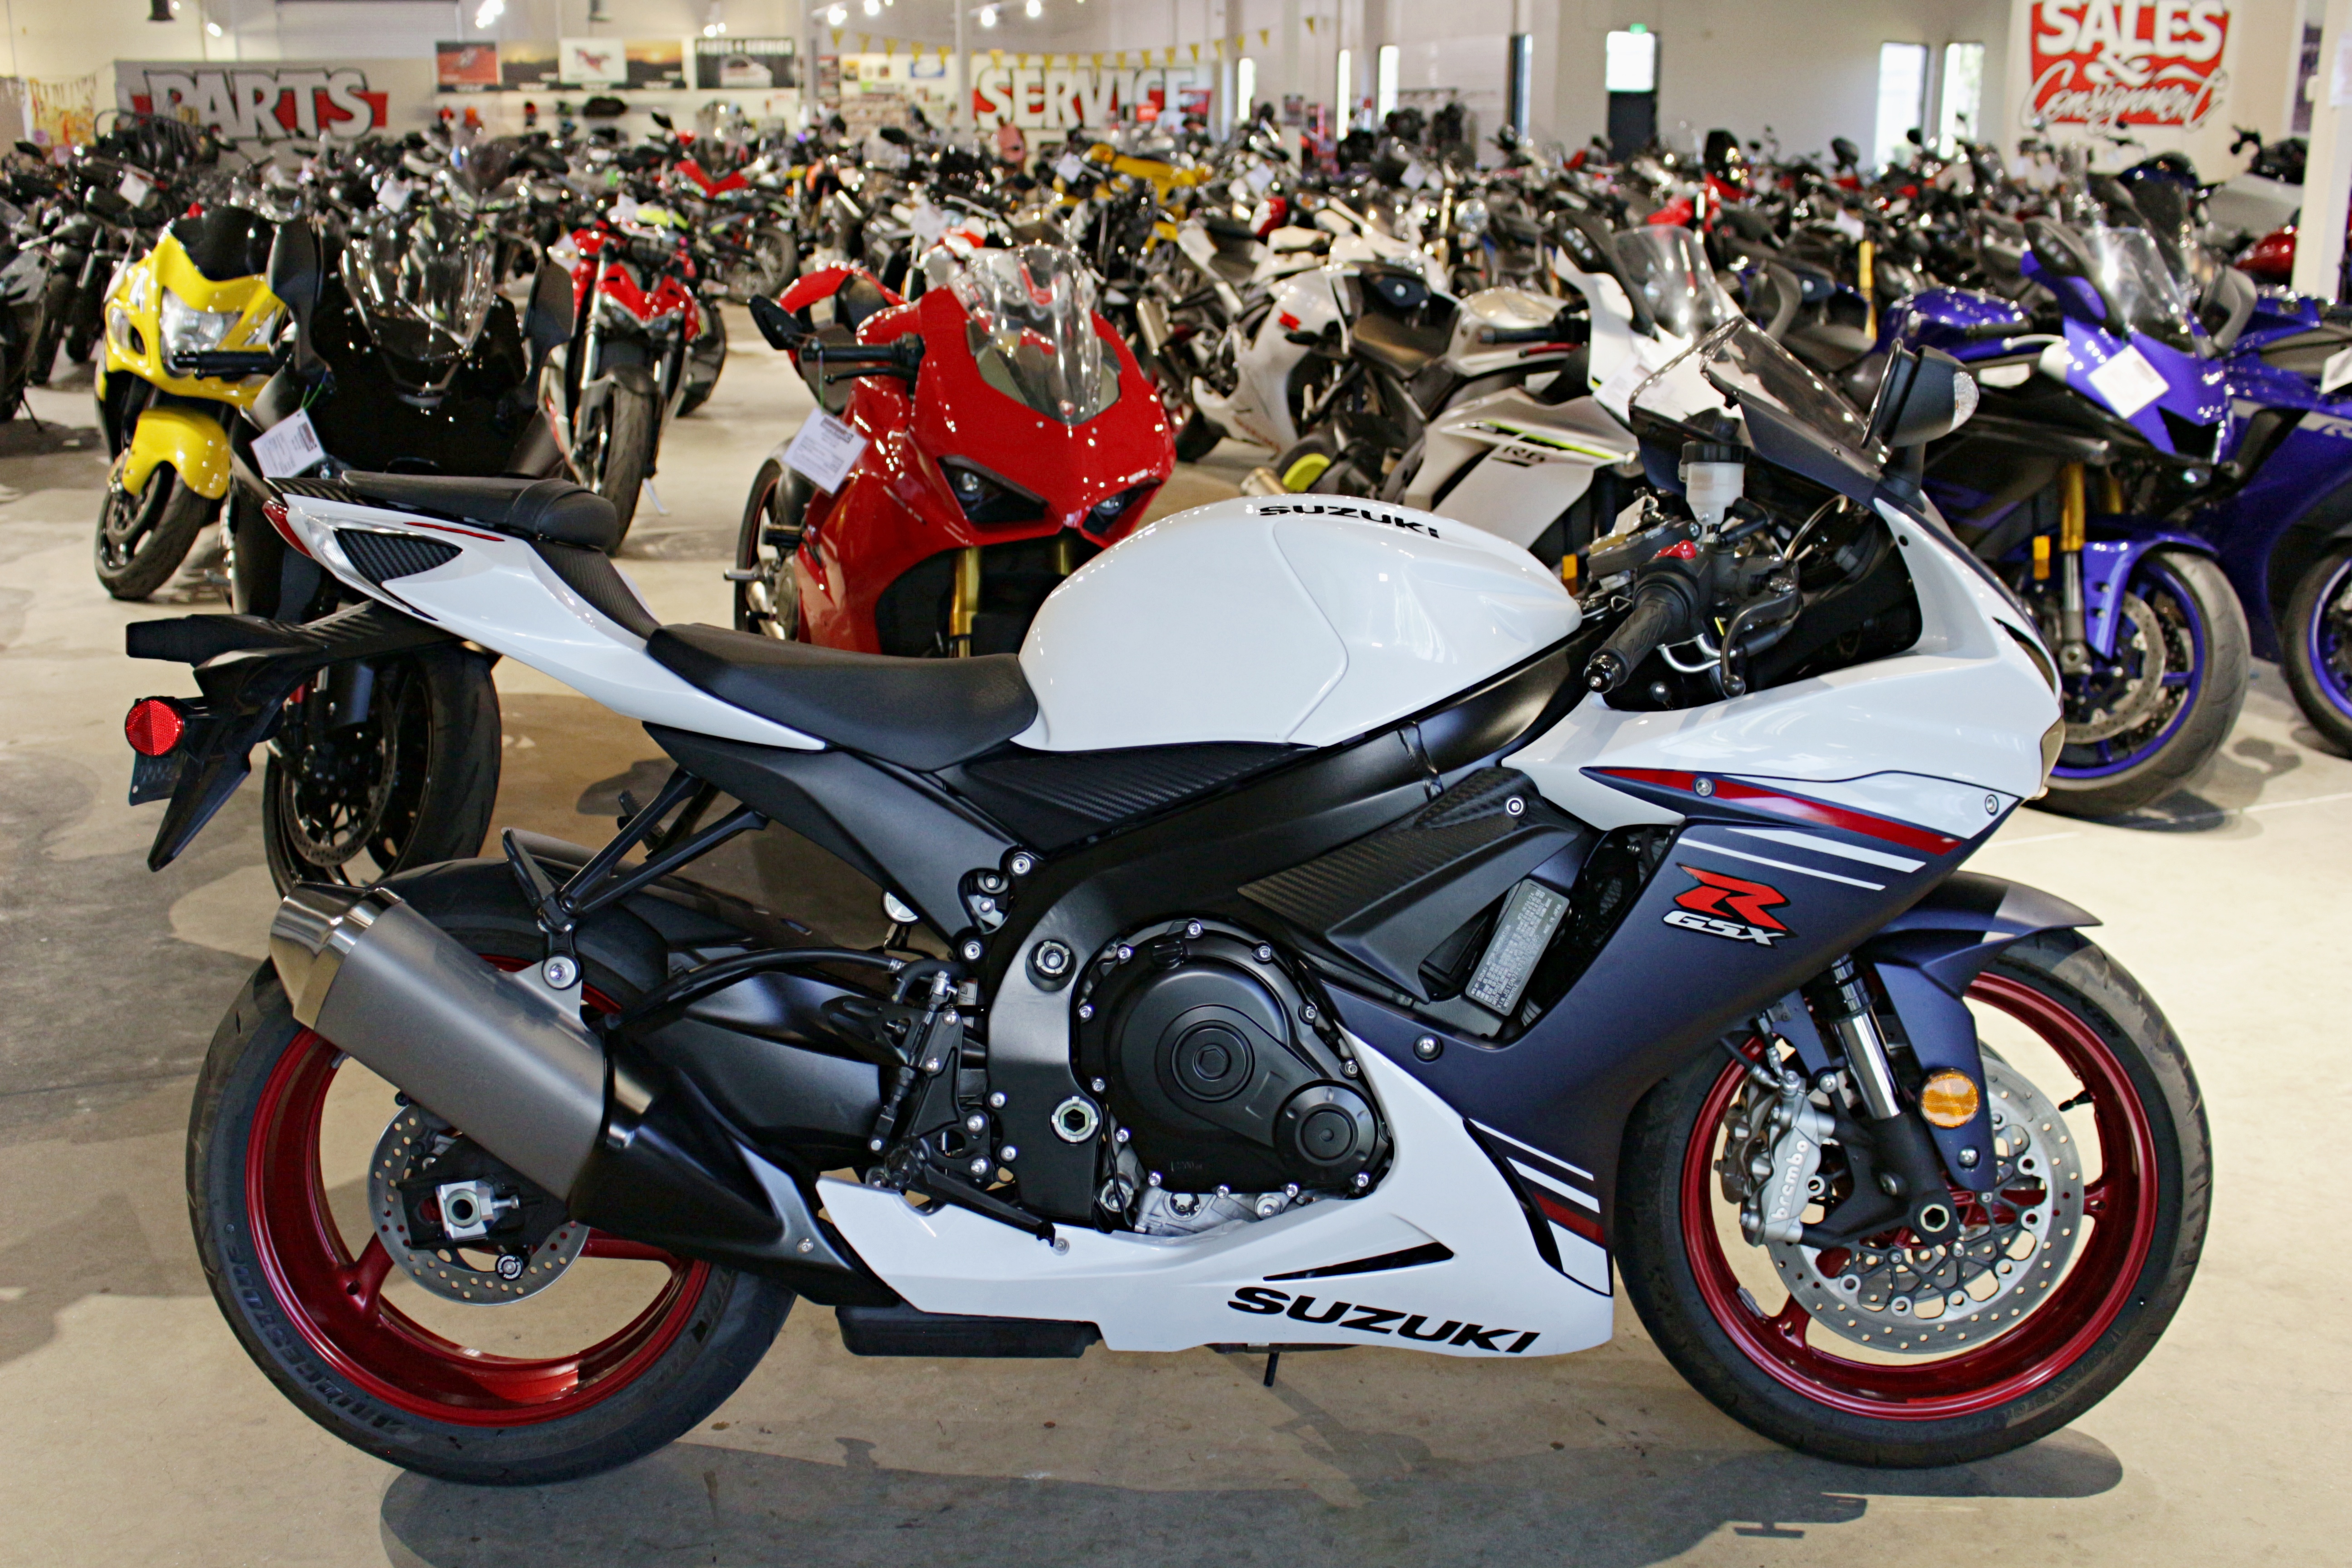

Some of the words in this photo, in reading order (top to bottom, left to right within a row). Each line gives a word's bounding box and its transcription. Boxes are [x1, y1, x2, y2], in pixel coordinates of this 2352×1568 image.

[2037, 0, 2224, 62] SALES
[144, 69, 375, 140] PARTS
[975, 66, 1196, 130] SERVICE
[2020, 62, 2229, 135] Consignment
[1259, 505, 1440, 539] SUZUKI
[1663, 910, 1786, 946] GSX
[1674, 863, 1790, 932] R
[1770, 1140, 1809, 1219] brembo
[1227, 1287, 1541, 1353] SUZUKI
